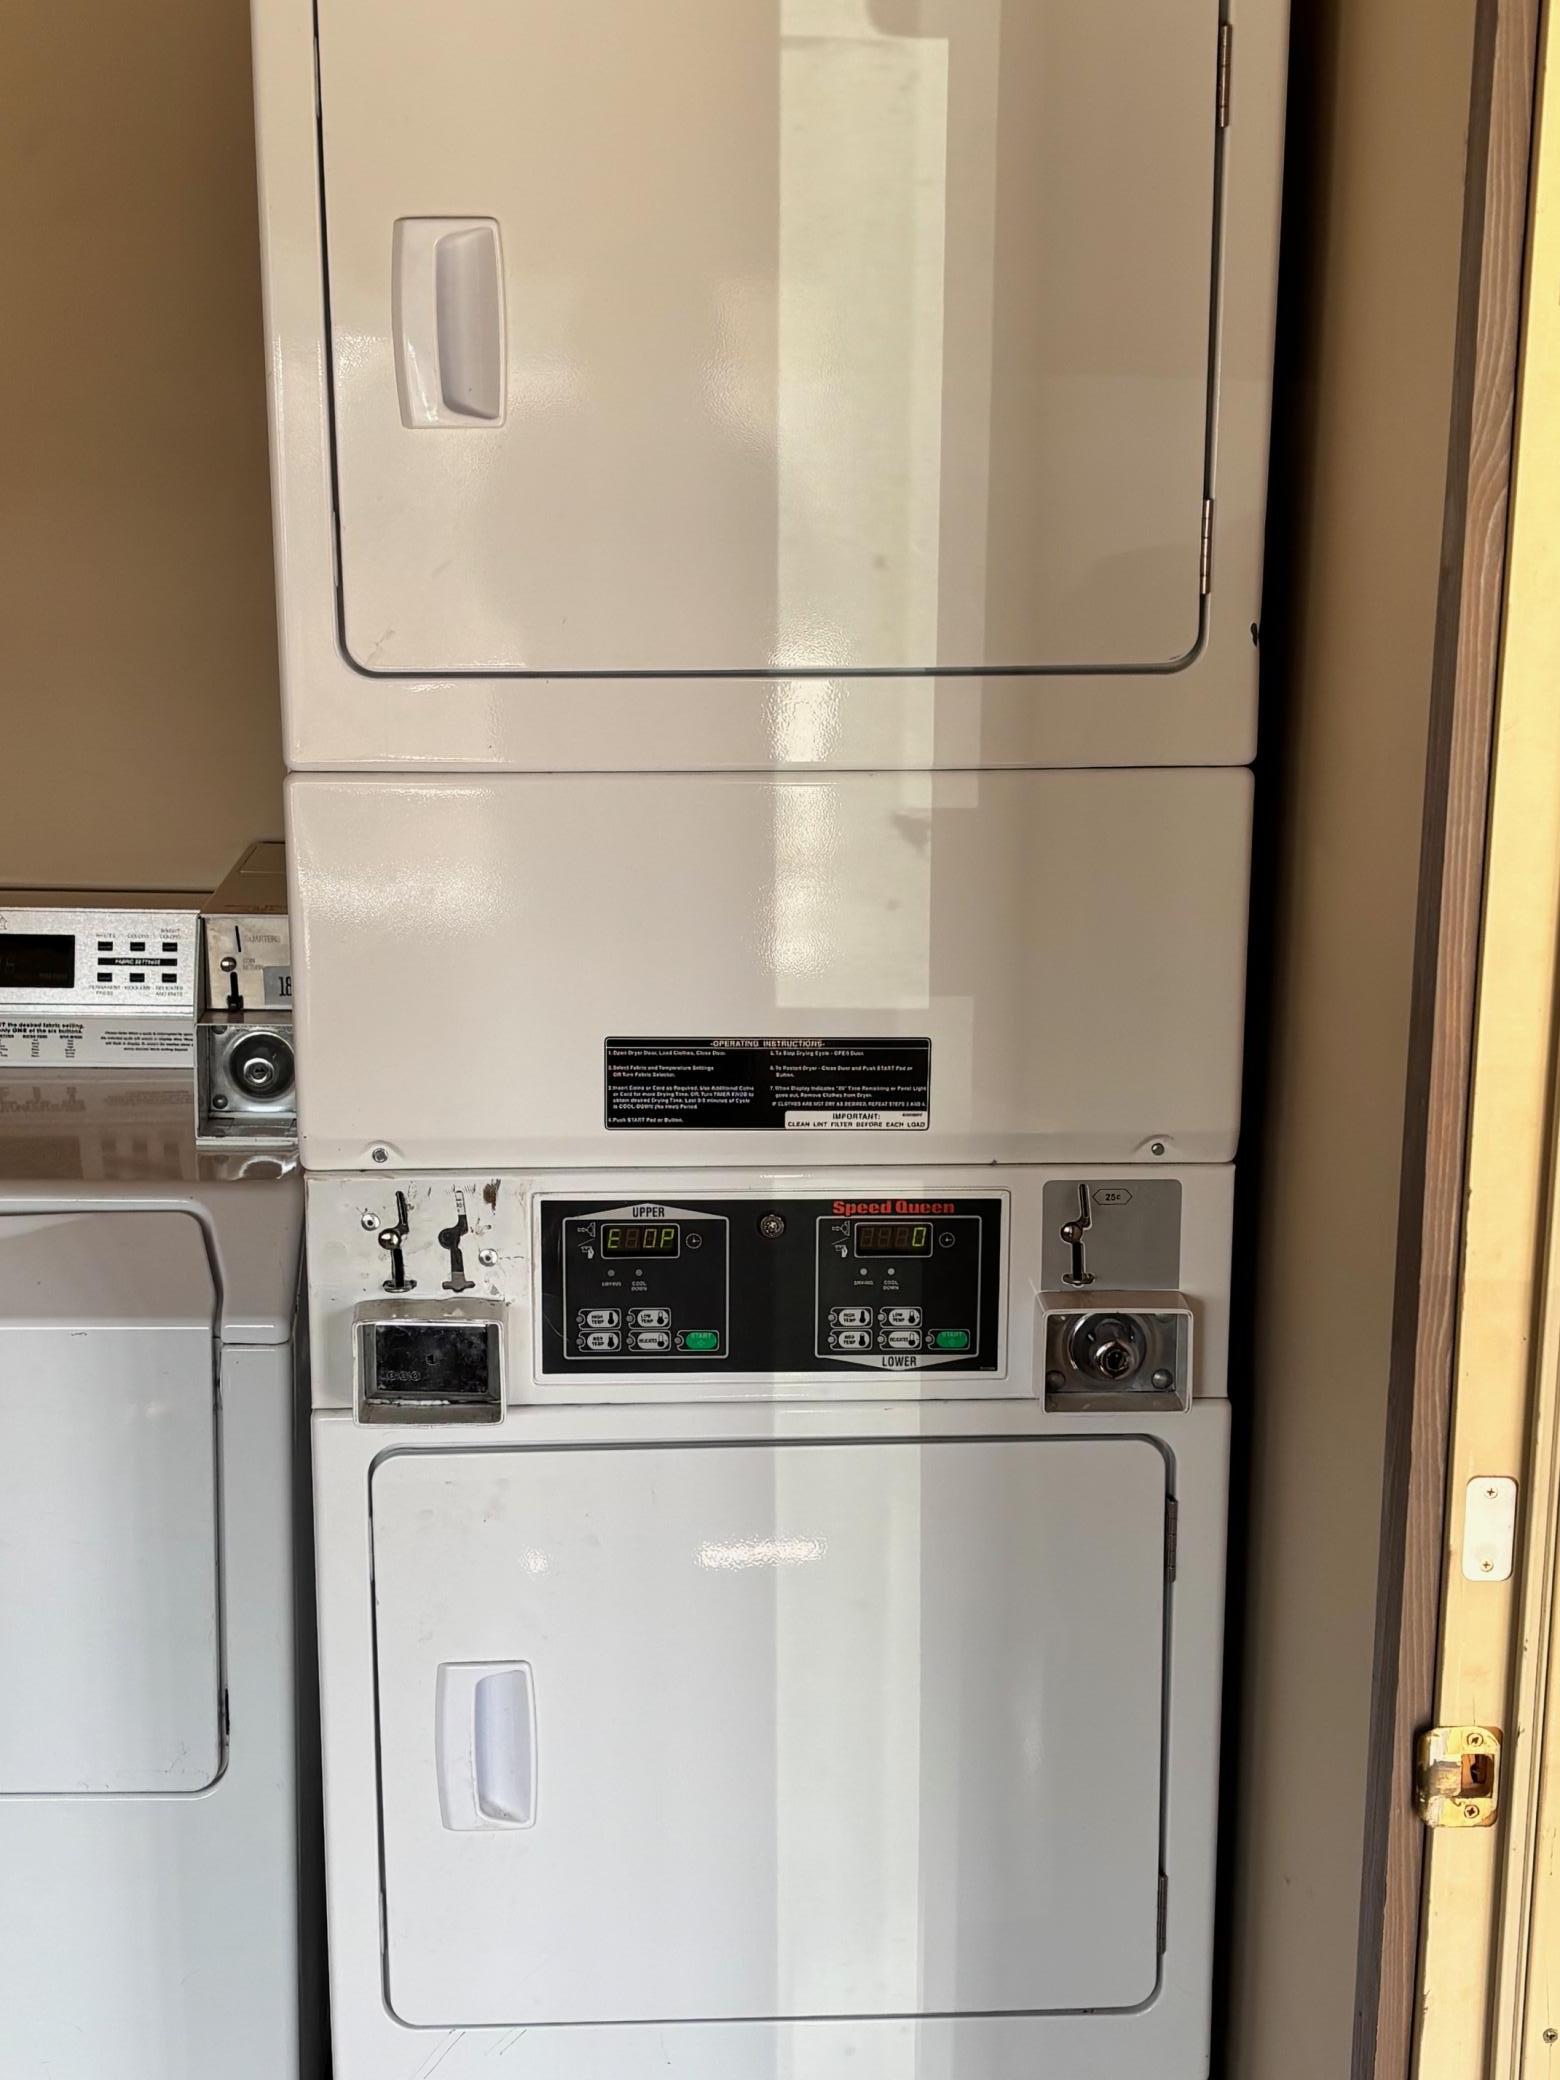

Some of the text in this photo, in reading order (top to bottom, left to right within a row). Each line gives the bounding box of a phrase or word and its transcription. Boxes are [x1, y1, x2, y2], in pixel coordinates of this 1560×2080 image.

[632, 1207, 665, 1217] UPPER
[832, 1200, 955, 1216] Speed Queen
[607, 1228, 621, 1248] E
[882, 1356, 917, 1367] LOWER
